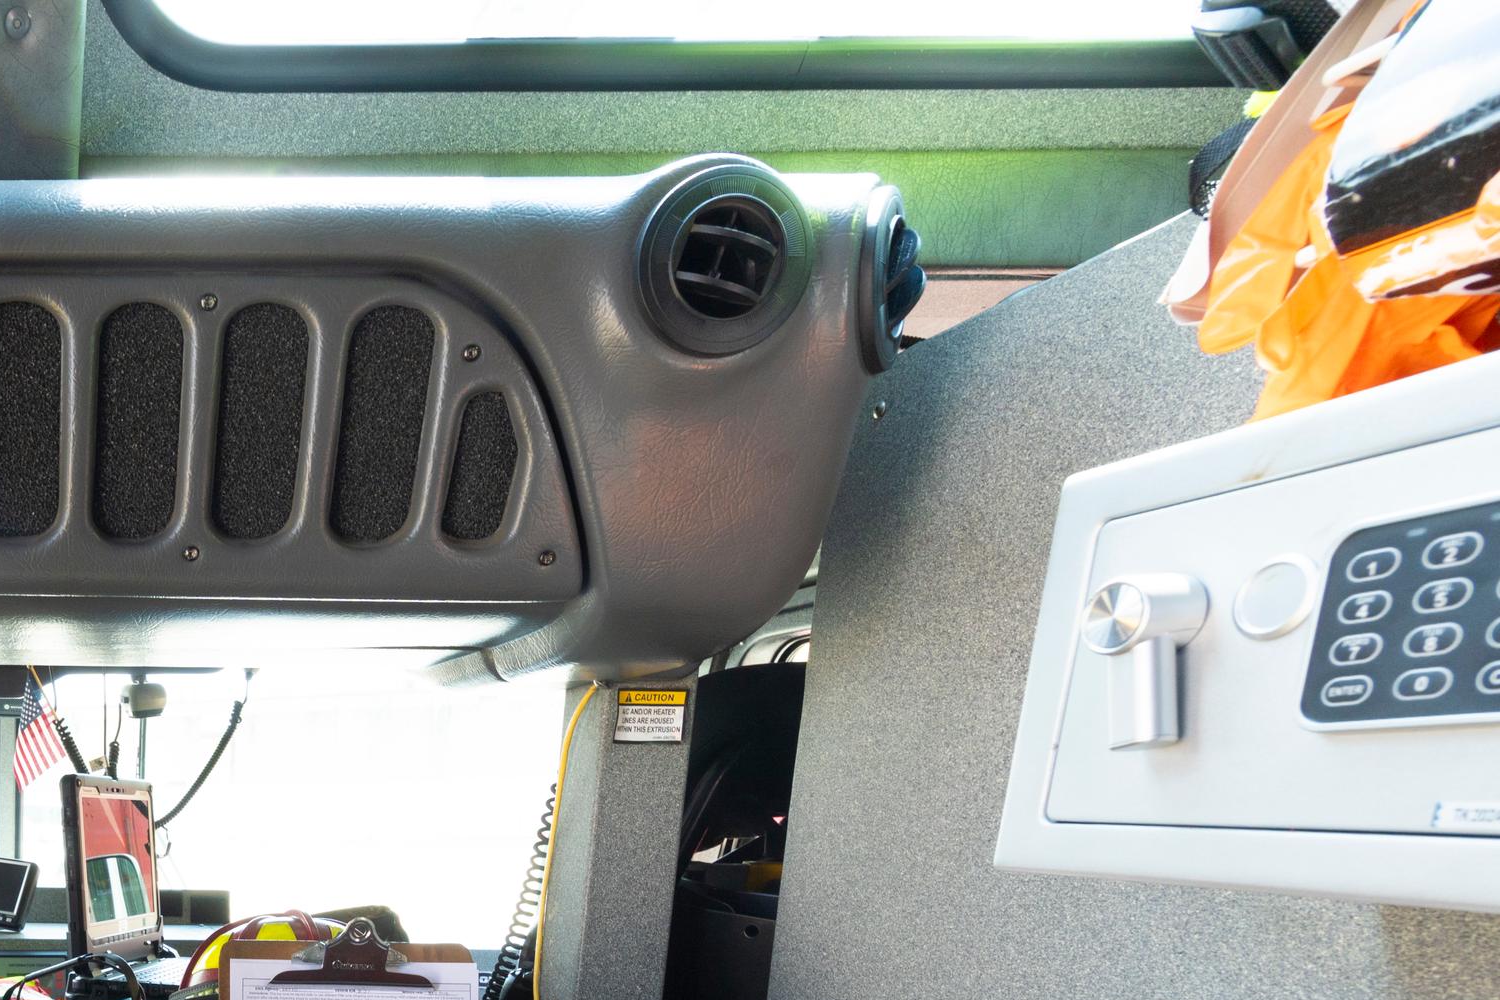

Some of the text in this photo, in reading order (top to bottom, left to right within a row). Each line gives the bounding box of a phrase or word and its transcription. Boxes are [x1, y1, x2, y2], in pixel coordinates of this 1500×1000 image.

[1367, 547, 1459, 576] 1 2
[1355, 592, 1449, 618] 4 5
[1348, 646, 1361, 660] 7
[634, 693, 675, 702] CAUTION
[1328, 685, 1364, 697] ENTER
